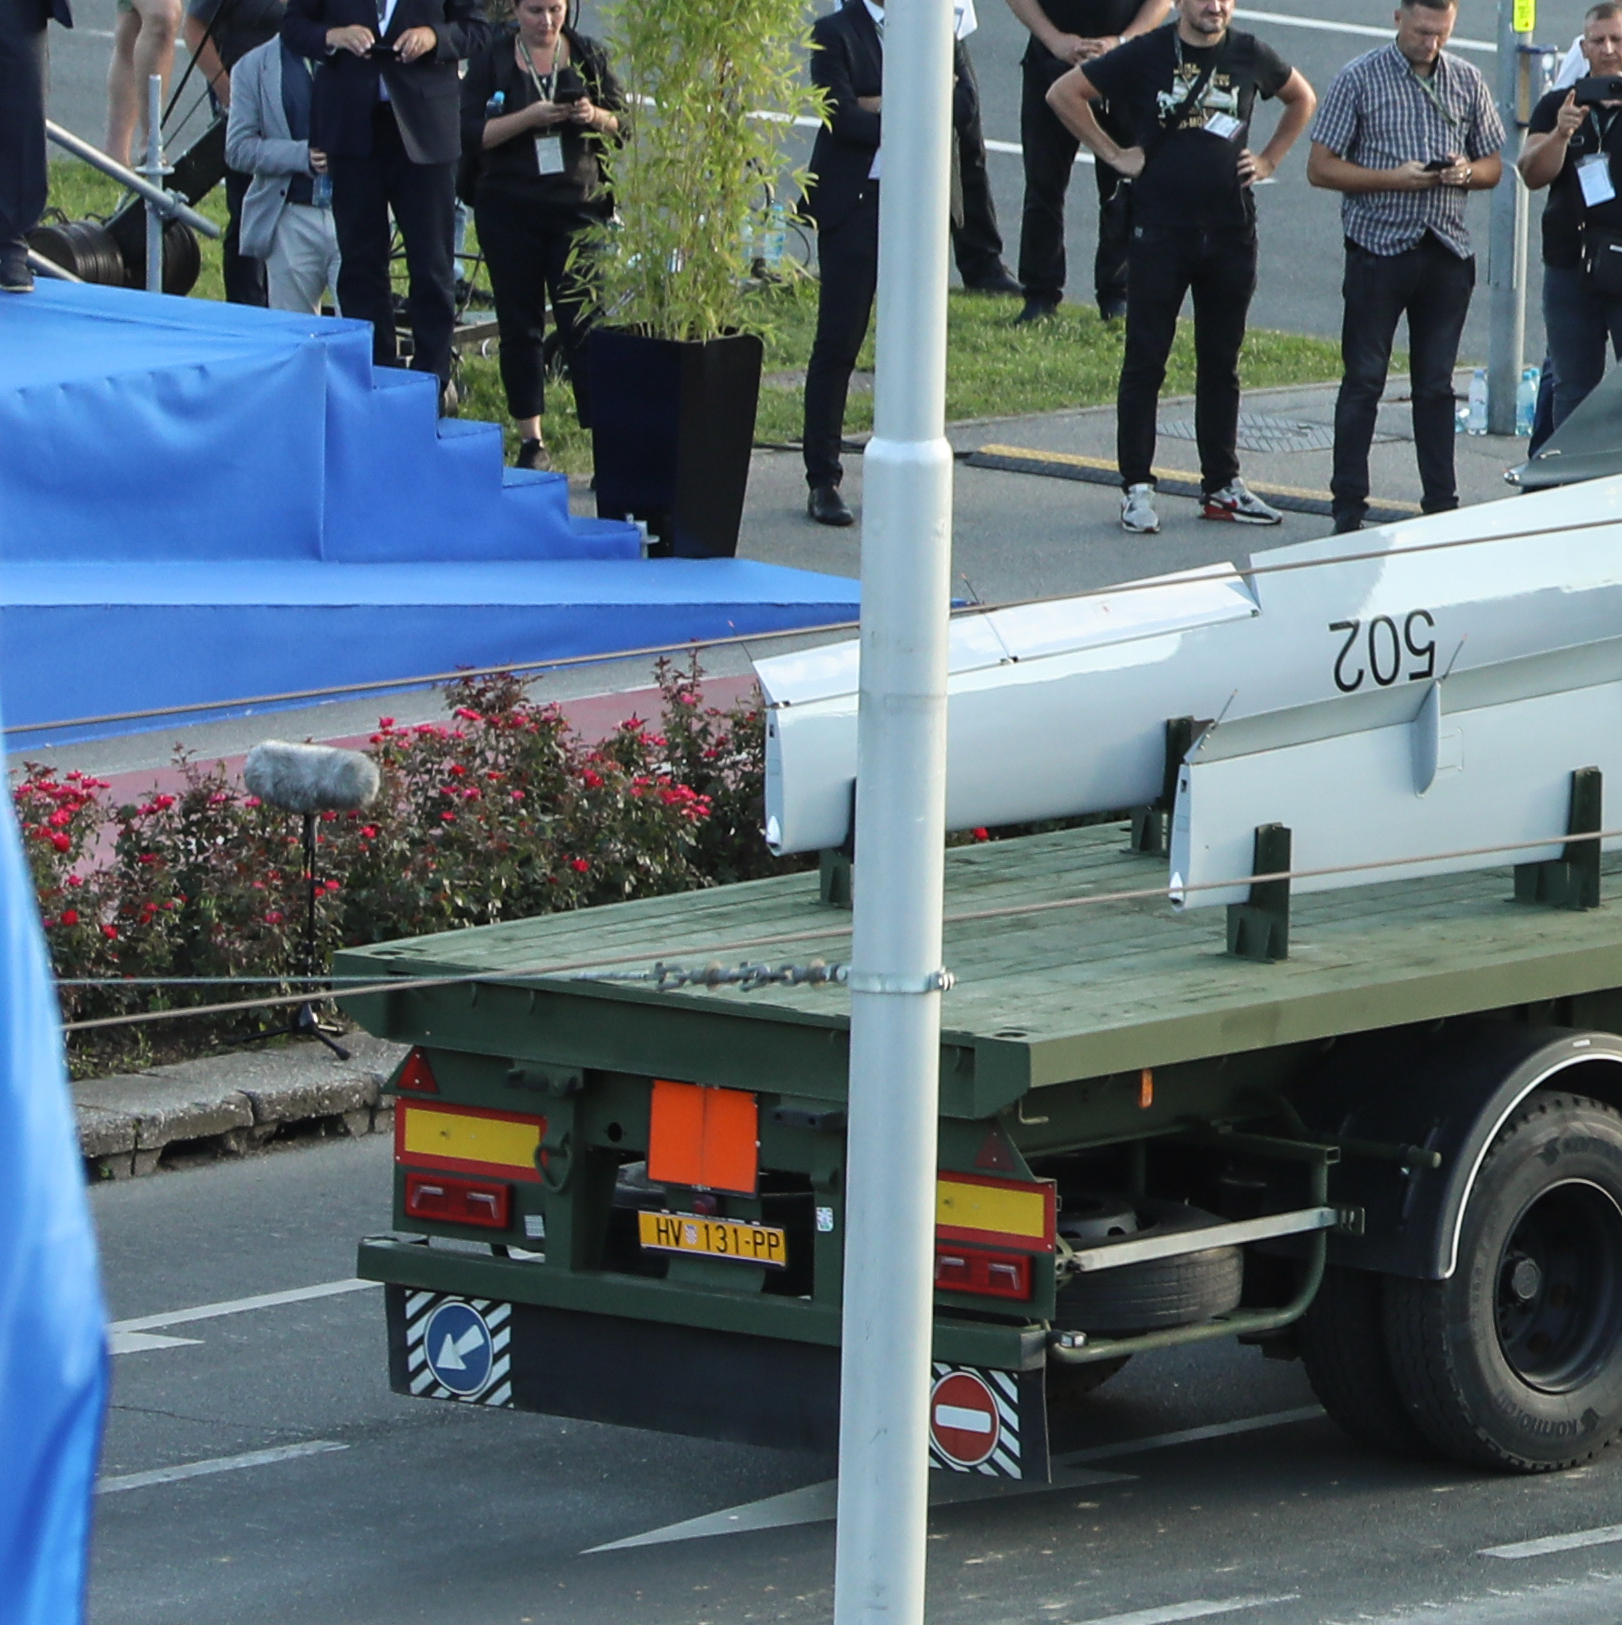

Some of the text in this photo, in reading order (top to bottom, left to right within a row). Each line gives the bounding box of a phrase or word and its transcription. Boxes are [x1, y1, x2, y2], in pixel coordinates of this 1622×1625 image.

[1328, 608, 1435, 693] 502
[656, 1217, 780, 1260] HV 131-PP
